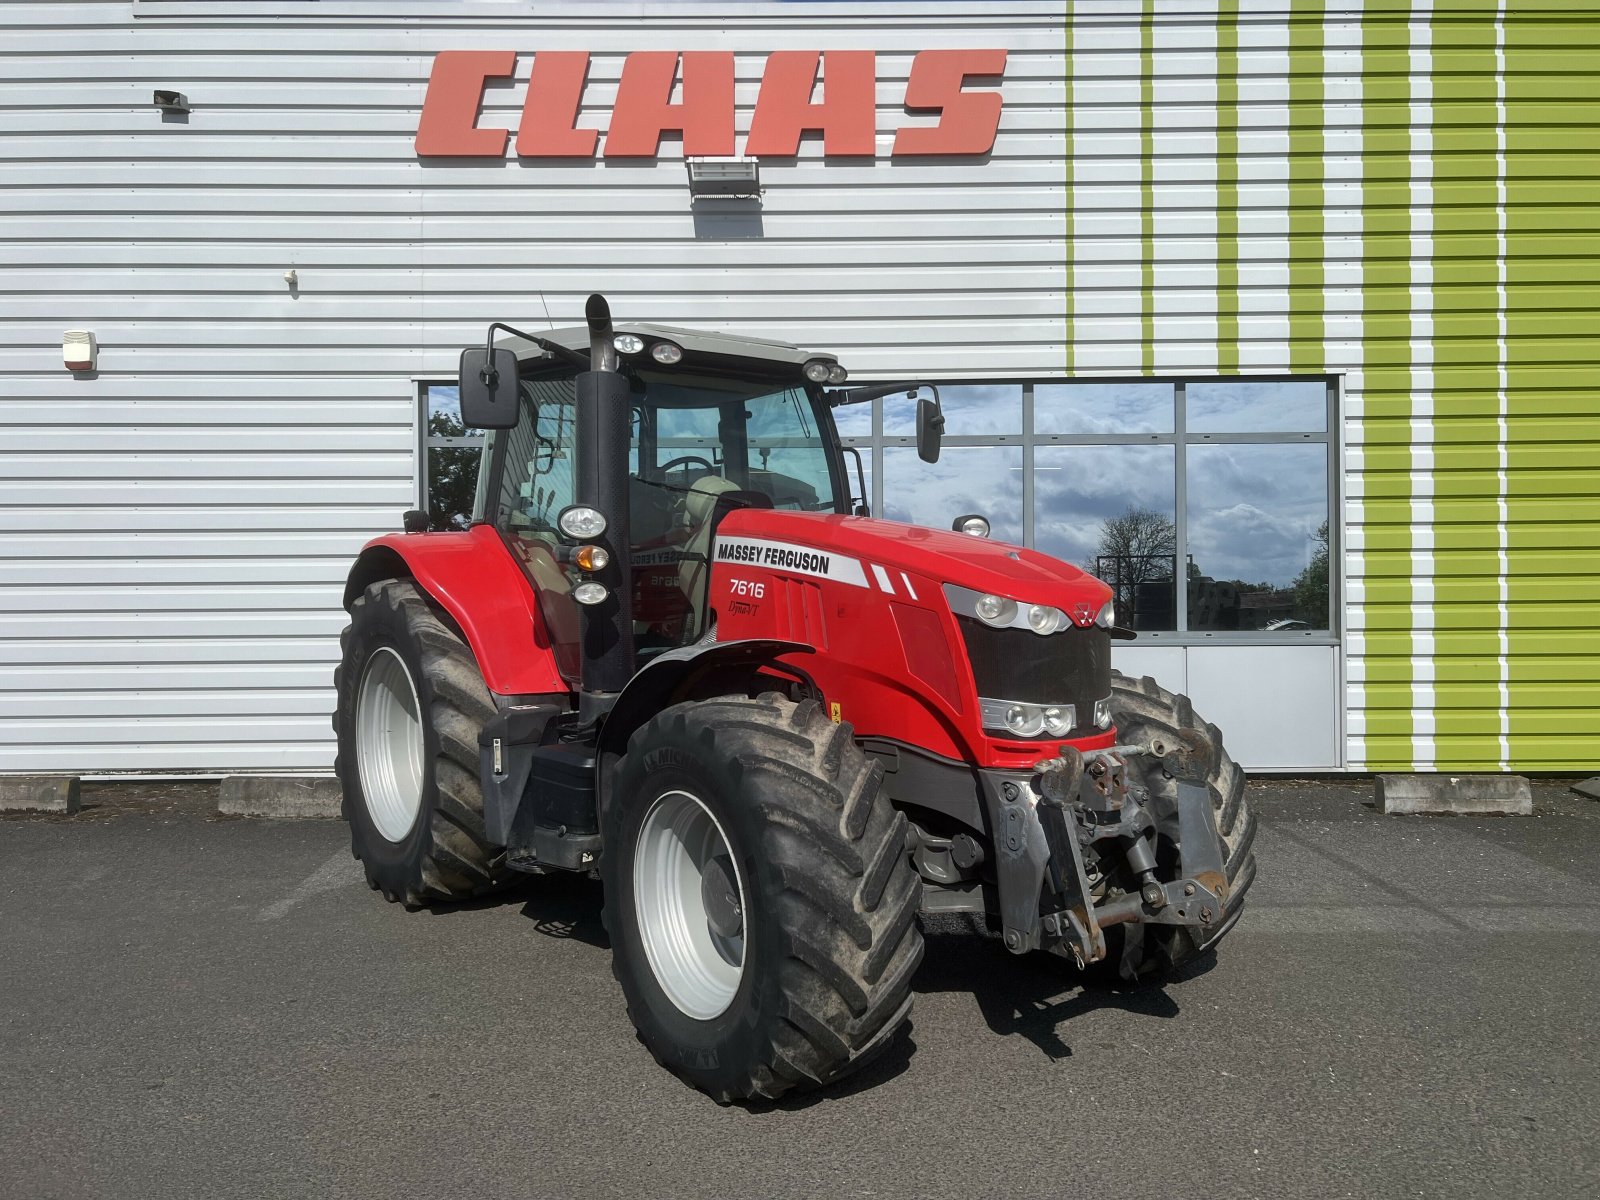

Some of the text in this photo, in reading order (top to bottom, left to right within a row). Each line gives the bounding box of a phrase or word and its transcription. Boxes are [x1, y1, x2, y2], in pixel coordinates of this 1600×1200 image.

[414, 49, 1009, 157] CLAAS
[718, 543, 830, 574] MASSEY FERGUSON
[730, 578, 765, 599] 7616
